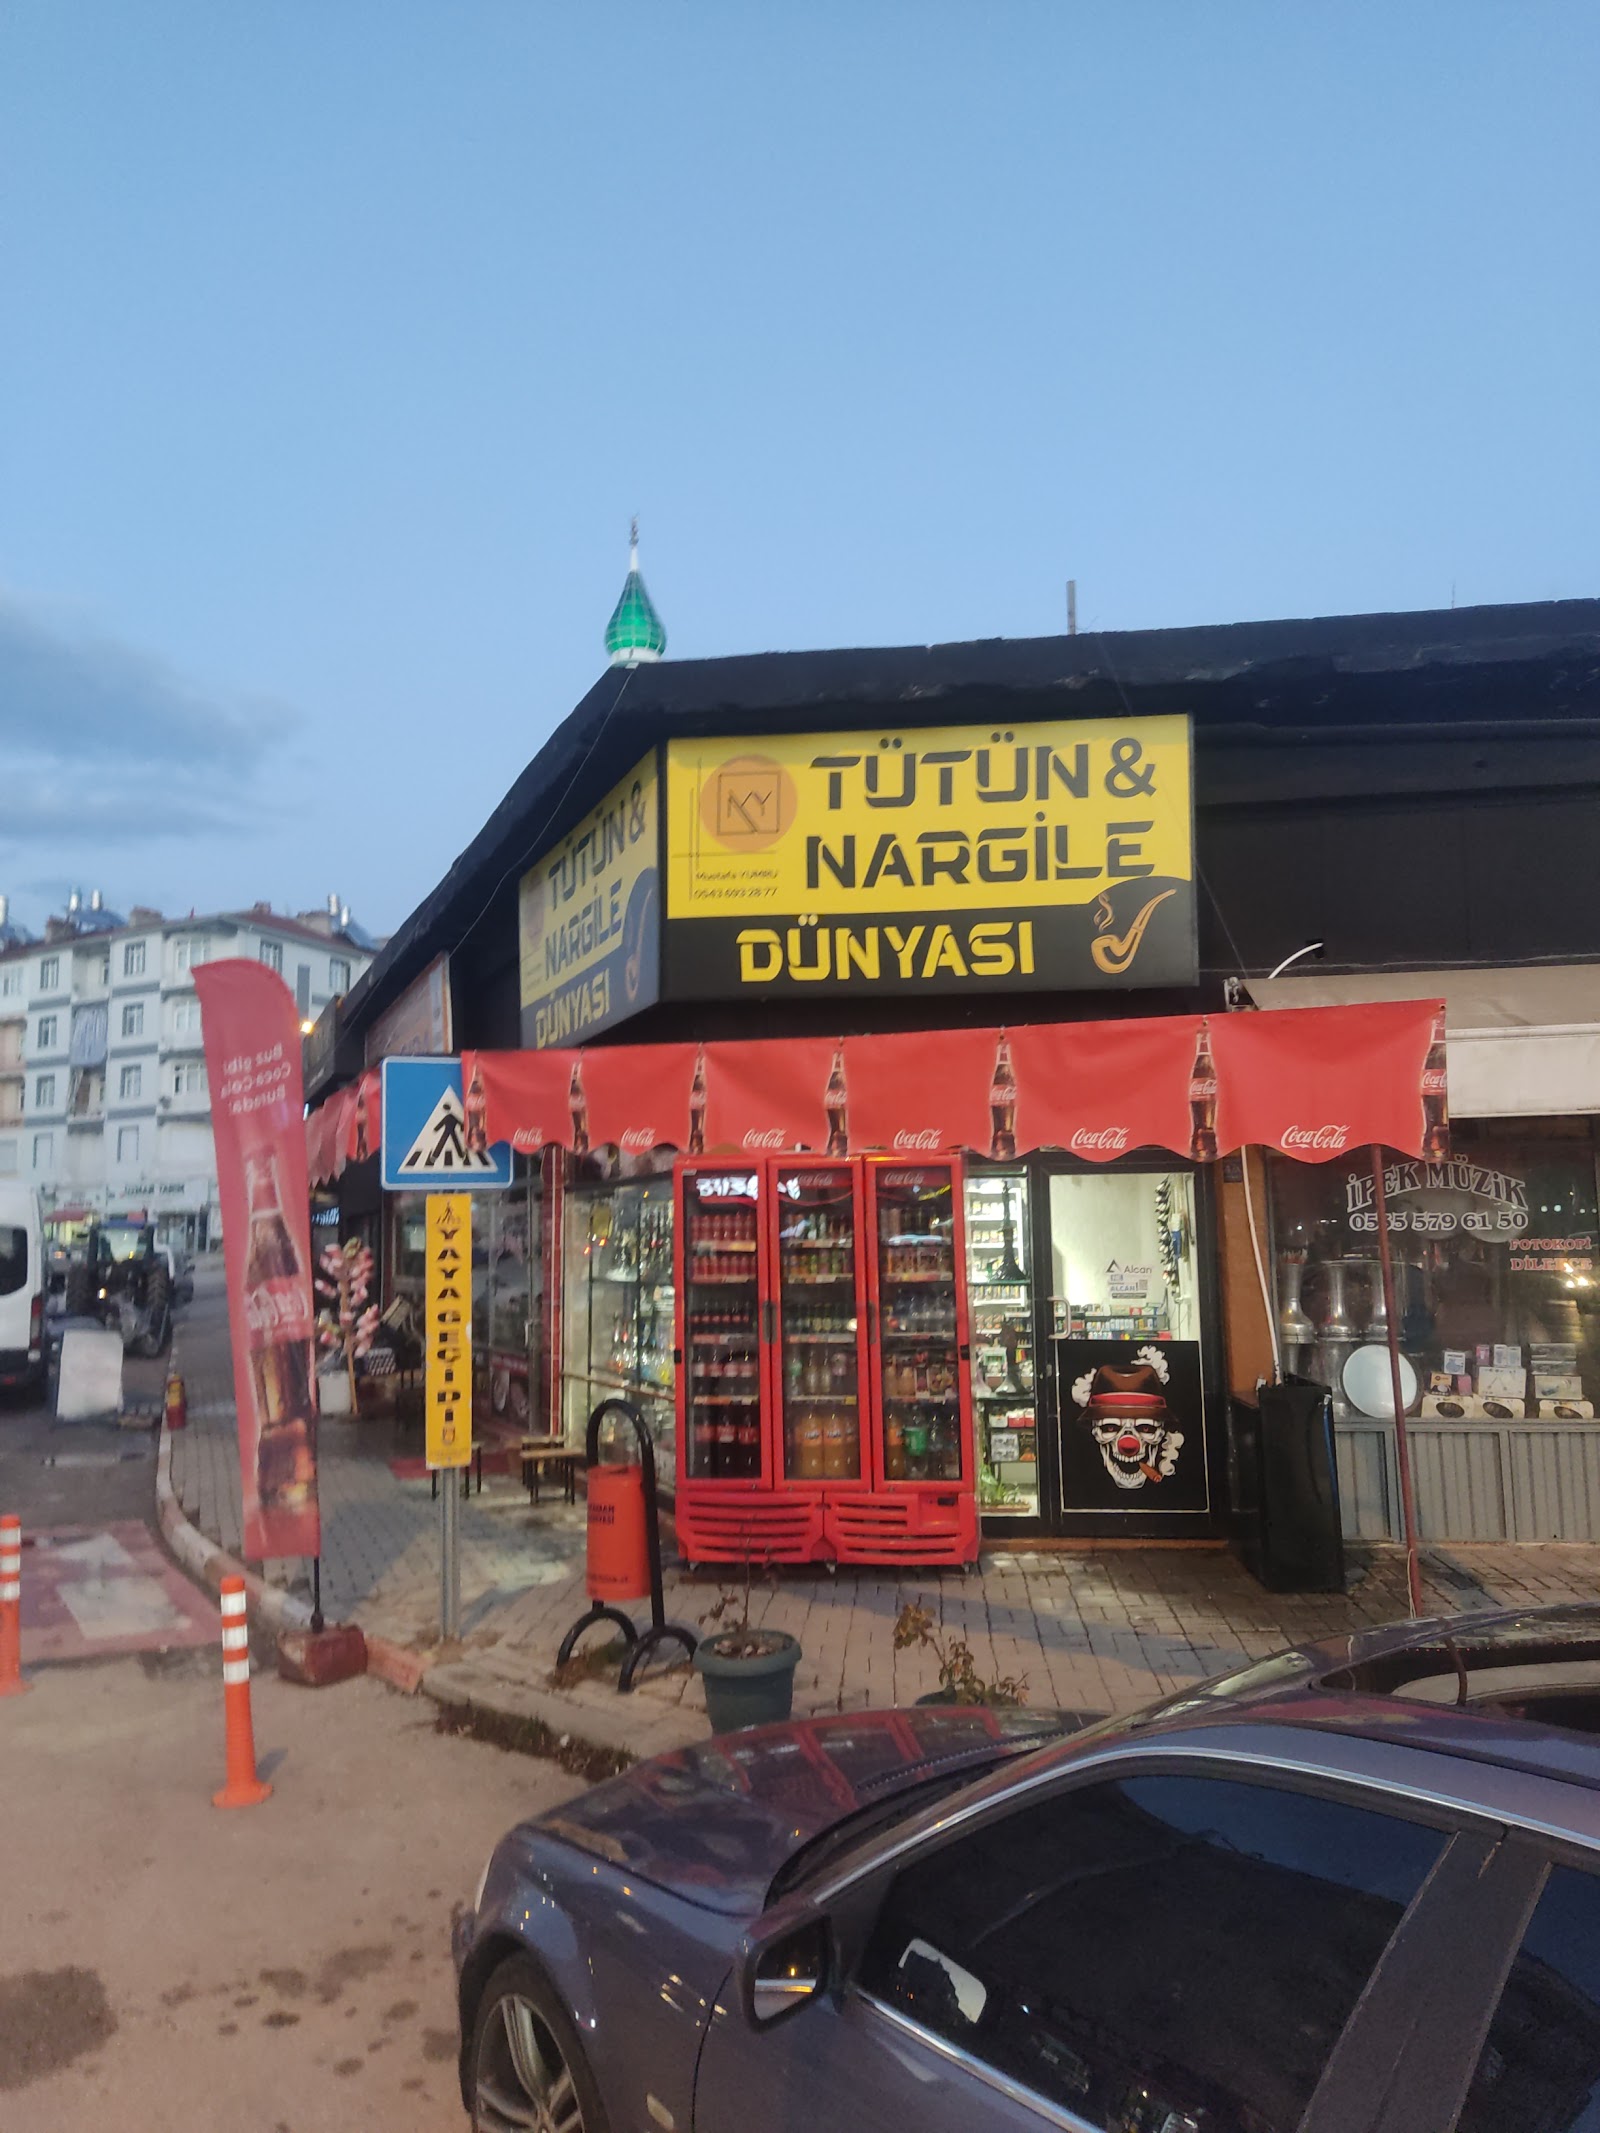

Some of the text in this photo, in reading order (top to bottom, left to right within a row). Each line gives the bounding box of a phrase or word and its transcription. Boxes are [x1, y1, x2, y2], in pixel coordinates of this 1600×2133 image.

[809, 732, 1158, 810] TÜTÜN &
[548, 800, 626, 911] TÜTÜN
[805, 811, 1156, 891] NARGİLE
[545, 878, 623, 981] NARGİLE
[735, 914, 1035, 982] DÜNYASI
[536, 968, 611, 1049] DÜNYASI
[620, 1127, 656, 1146] Coca-Cola
[742, 1128, 787, 1148] Coca-Cola
[893, 1129, 943, 1150] Coca-Cola
[1070, 1127, 1130, 1149] Coca-Cola
[1280, 1125, 1350, 1149] Coca-Cola
[1346, 1154, 1528, 1213] İPEK MÜZİK
[1411, 1211, 1457, 1231] 579
[1461, 1211, 1492, 1230] 61
[1497, 1211, 1529, 1230] 50
[1509, 1235, 1593, 1250] FOTOKOPİ
[437, 1228, 461, 1300] YAYA
[1124, 1264, 1152, 1274] Alcan
